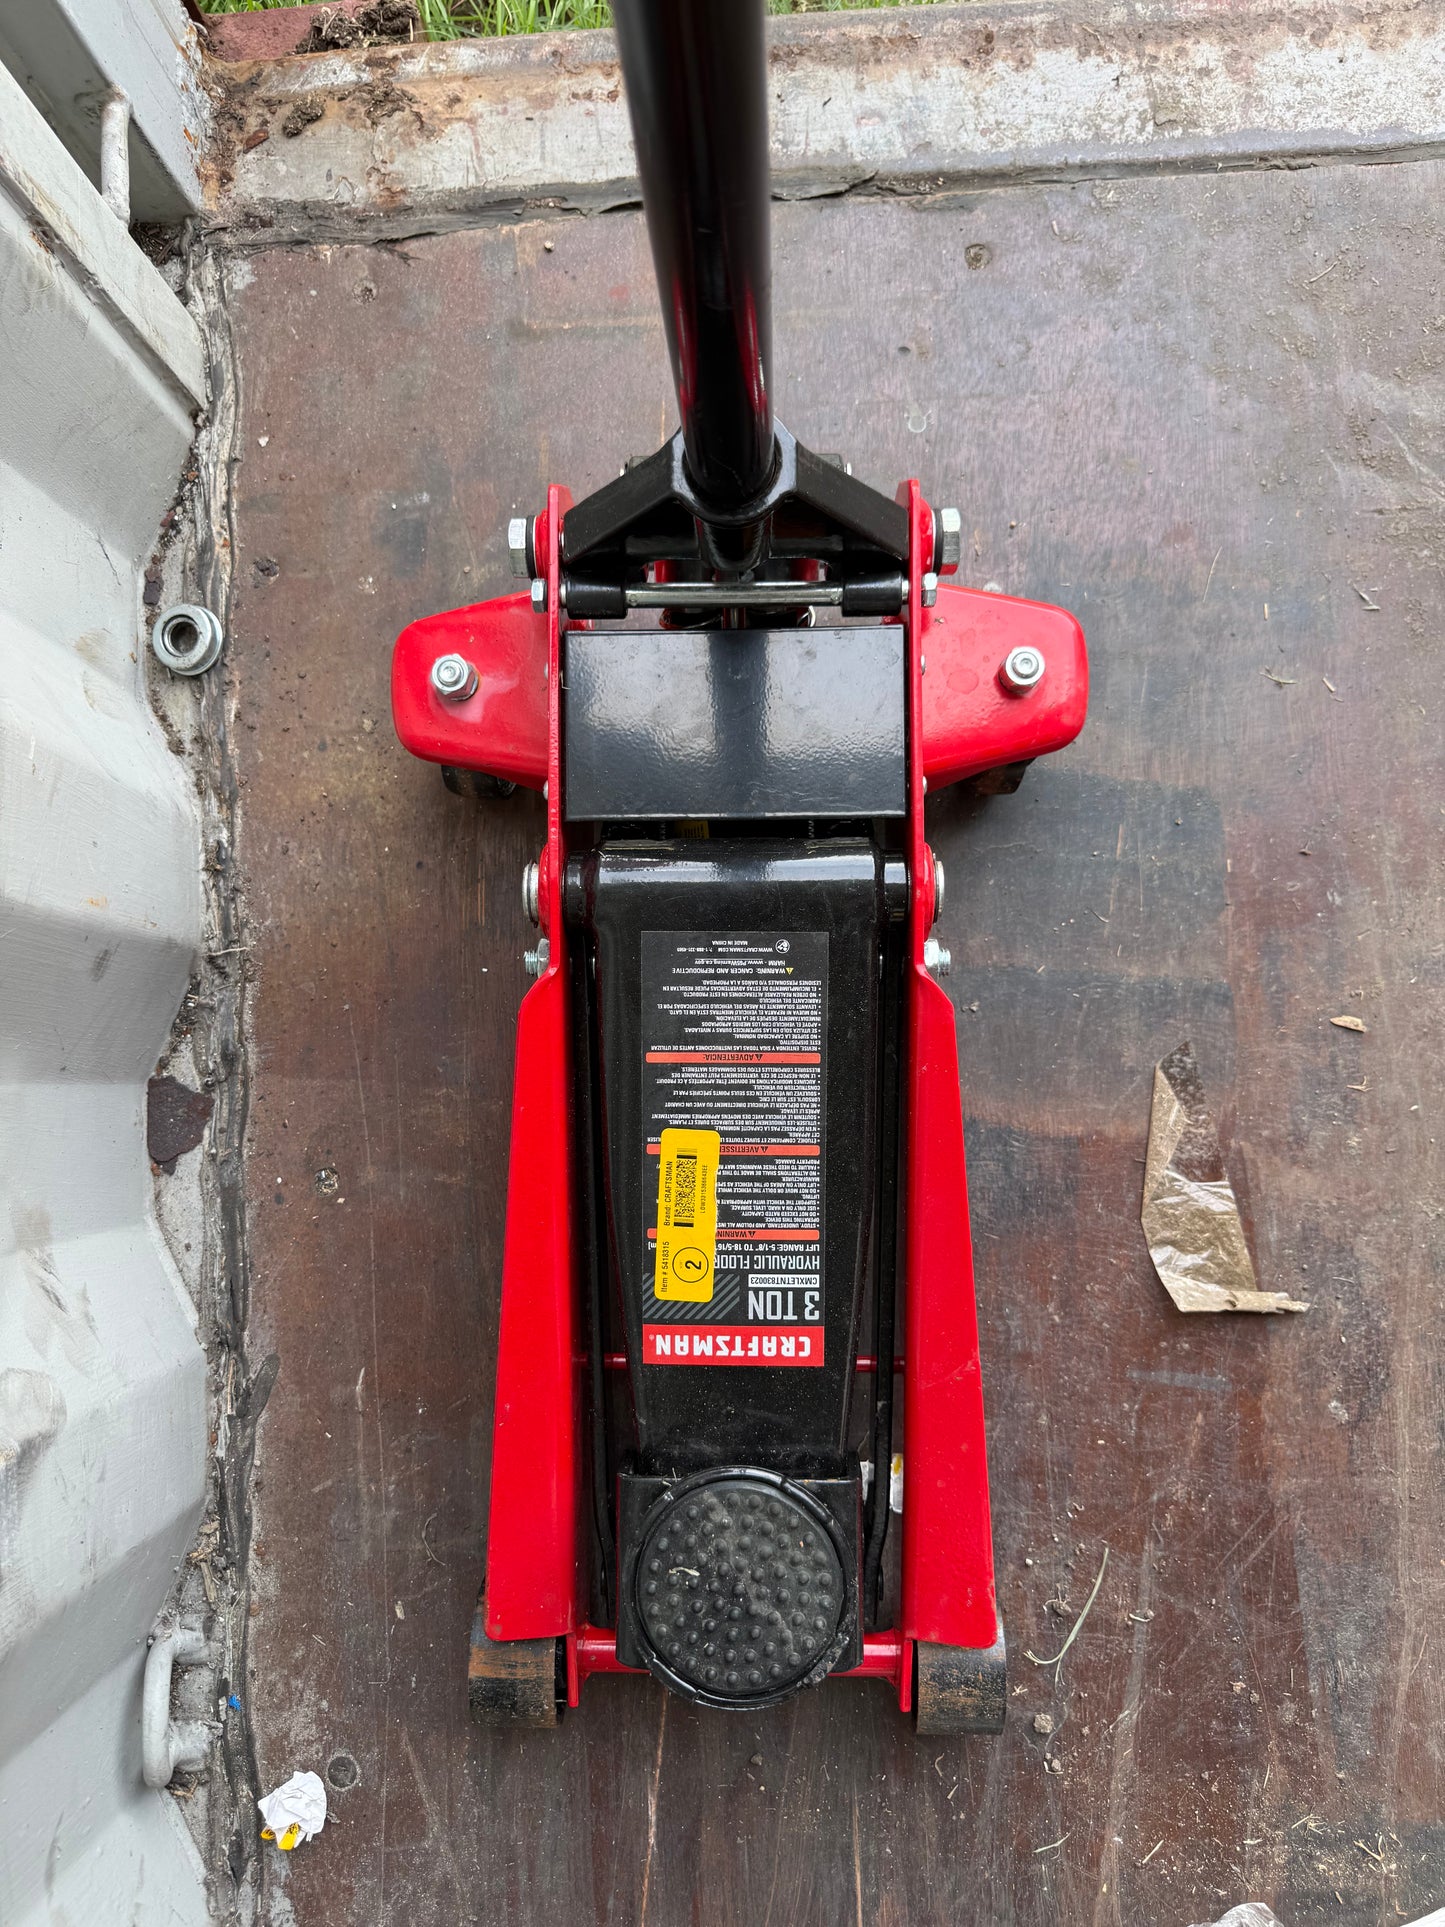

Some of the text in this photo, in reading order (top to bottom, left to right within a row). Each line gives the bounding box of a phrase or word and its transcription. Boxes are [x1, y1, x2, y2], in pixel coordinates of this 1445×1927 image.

[664, 1161, 673, 1203] CRAFTSMAN
[777, 1243, 804, 1251] RANGE:
[806, 1243, 820, 1251] LIFT
[685, 1260, 702, 1270] 2
[754, 1255, 820, 1269] HYDRAULIC
[749, 1290, 820, 1320] 3 TON
[656, 1334, 811, 1357] CRAFTSMAN
